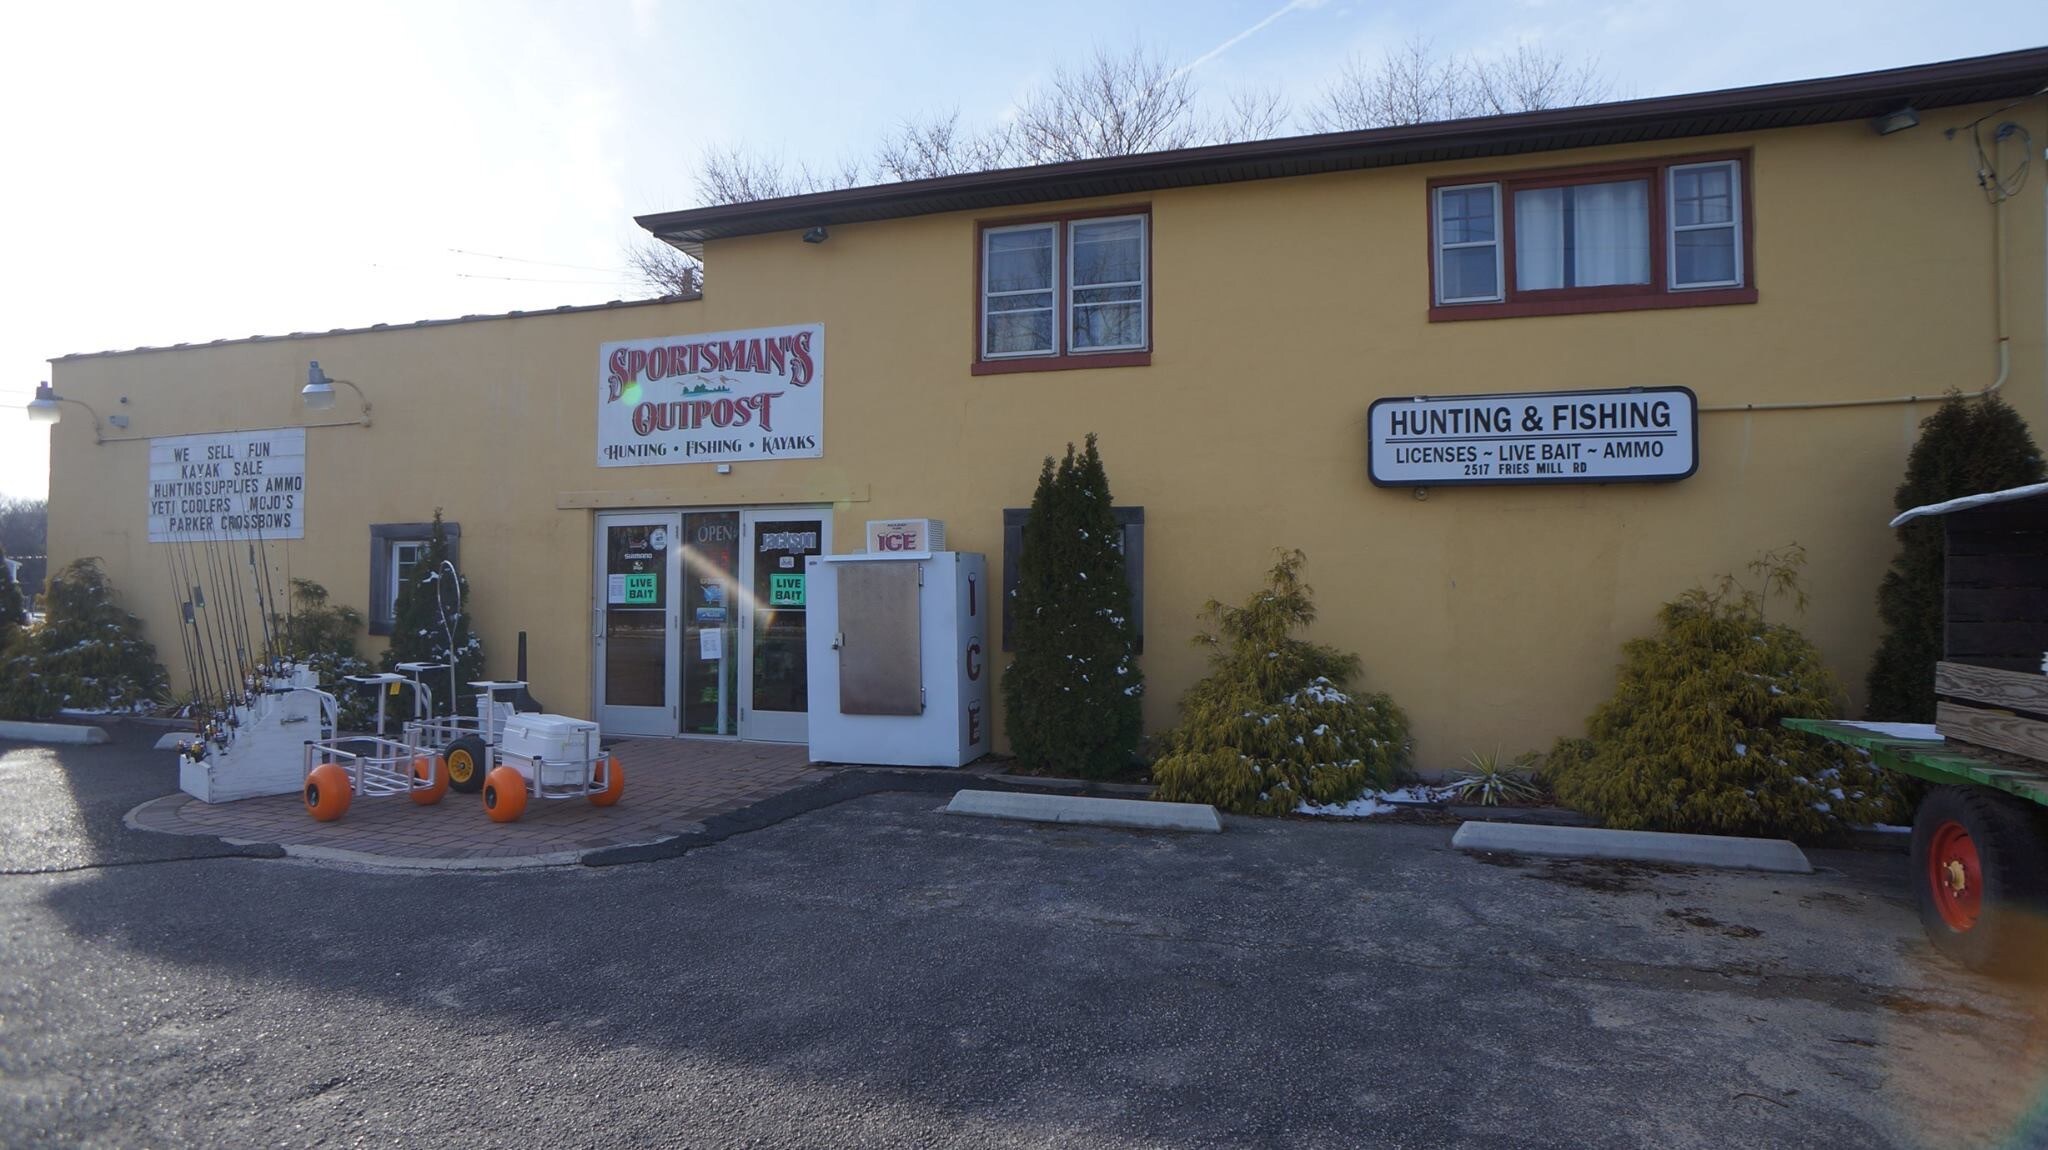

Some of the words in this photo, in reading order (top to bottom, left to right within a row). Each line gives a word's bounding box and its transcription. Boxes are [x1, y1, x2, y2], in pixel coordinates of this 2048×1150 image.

[607, 331, 815, 404] SPORTSMAN'S
[632, 391, 785, 436] OUTPOST
[1391, 407, 1511, 435] HUNTING
[1521, 405, 1543, 432] &
[1553, 401, 1670, 431] FISHING
[174, 448, 190, 462] WE
[207, 445, 234, 460] SELL
[248, 442, 270, 457] FUN
[604, 443, 667, 460] HUNTING
[686, 439, 742, 457] FISHING
[762, 435, 816, 455] KAYAKS
[1396, 446, 1477, 464] LICENSES
[1499, 445, 1536, 461] LIVE
[1542, 443, 1581, 460] BAIT
[1603, 441, 1664, 458] AMMO
[181, 464, 220, 479] KAYAK
[234, 461, 263, 476] SALE
[1464, 464, 1490, 475] 2517
[1499, 463, 1530, 475] FRIES
[1536, 463, 1563, 473] MILL
[1573, 462, 1587, 473] RD
[265, 476, 302, 493] AMMO
[152, 501, 176, 515] YETI
[181, 498, 231, 514] COOLERS
[250, 495, 294, 511] MOJO'S
[169, 516, 213, 532] PARKER
[220, 513, 291, 530] CROSSBOWS
[697, 525, 735, 542] OPEN
[877, 532, 916, 551] ICE
[630, 579, 653, 588] LIVE
[776, 579, 801, 588] LIVE
[629, 589, 654, 599] BAIT
[775, 590, 802, 600] BAIT
